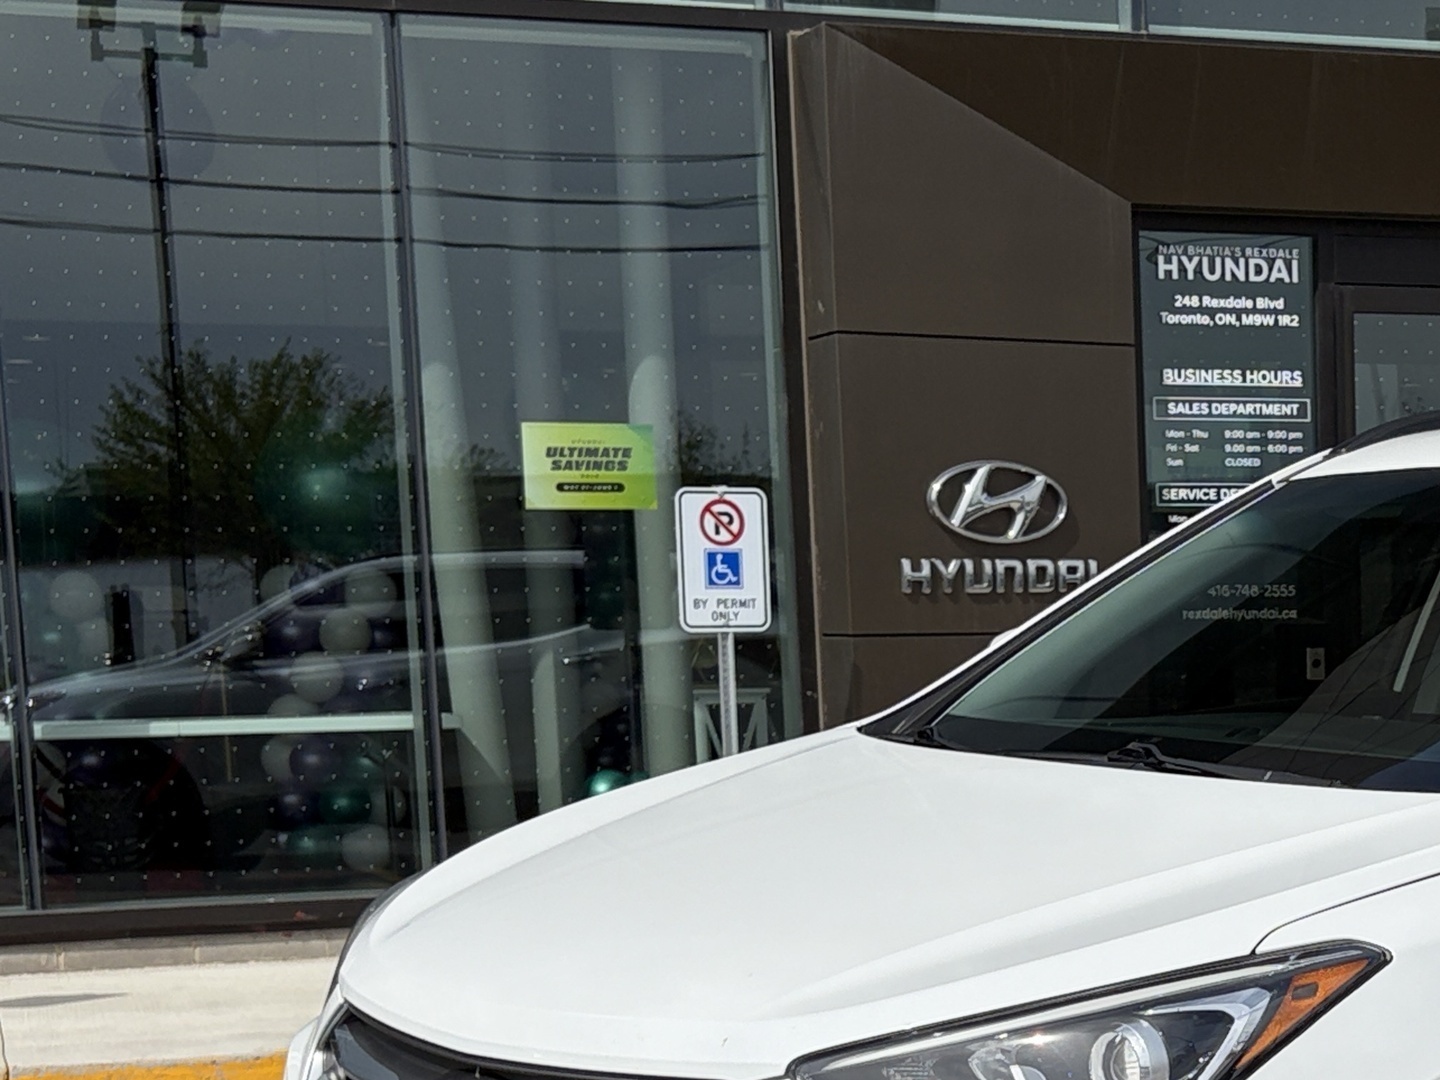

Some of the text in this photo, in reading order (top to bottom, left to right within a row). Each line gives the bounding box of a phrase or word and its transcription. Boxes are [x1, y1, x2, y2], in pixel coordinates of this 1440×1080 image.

[1158, 244, 1300, 259] NAV BHATIA'S REXDALE
[1157, 255, 1300, 283] HYUNDAI
[1174, 294, 1285, 310] 248 Rexdale Blvd
[1160, 312, 1300, 328] Toronto, ON, M9W 1R2
[1162, 368, 1303, 385] BUSINESS HOURS
[1167, 402, 1300, 417] SALES DEPARTMENT
[1165, 429, 1185, 439] Mon
[1191, 429, 1209, 439] Thu
[1245, 431, 1260, 439] am
[1288, 431, 1303, 441] pm
[545, 446, 634, 459] ULTIMATE
[1165, 443, 1178, 452] Fri
[1184, 443, 1200, 453] Sat
[1246, 445, 1261, 453] am
[1288, 445, 1303, 455] pm
[550, 459, 629, 472] SAVINGS
[1166, 457, 1184, 467] Sun
[1224, 457, 1262, 467] CLOSED
[1162, 488, 1218, 501] SERVICE
[900, 557, 1099, 595] HYUNDAI
[1207, 584, 1297, 597] 416-748-2555
[693, 598, 757, 610] BY PERMIT
[711, 611, 740, 622] ONLY
[1182, 607, 1298, 622] rexdalehyundai.ca
